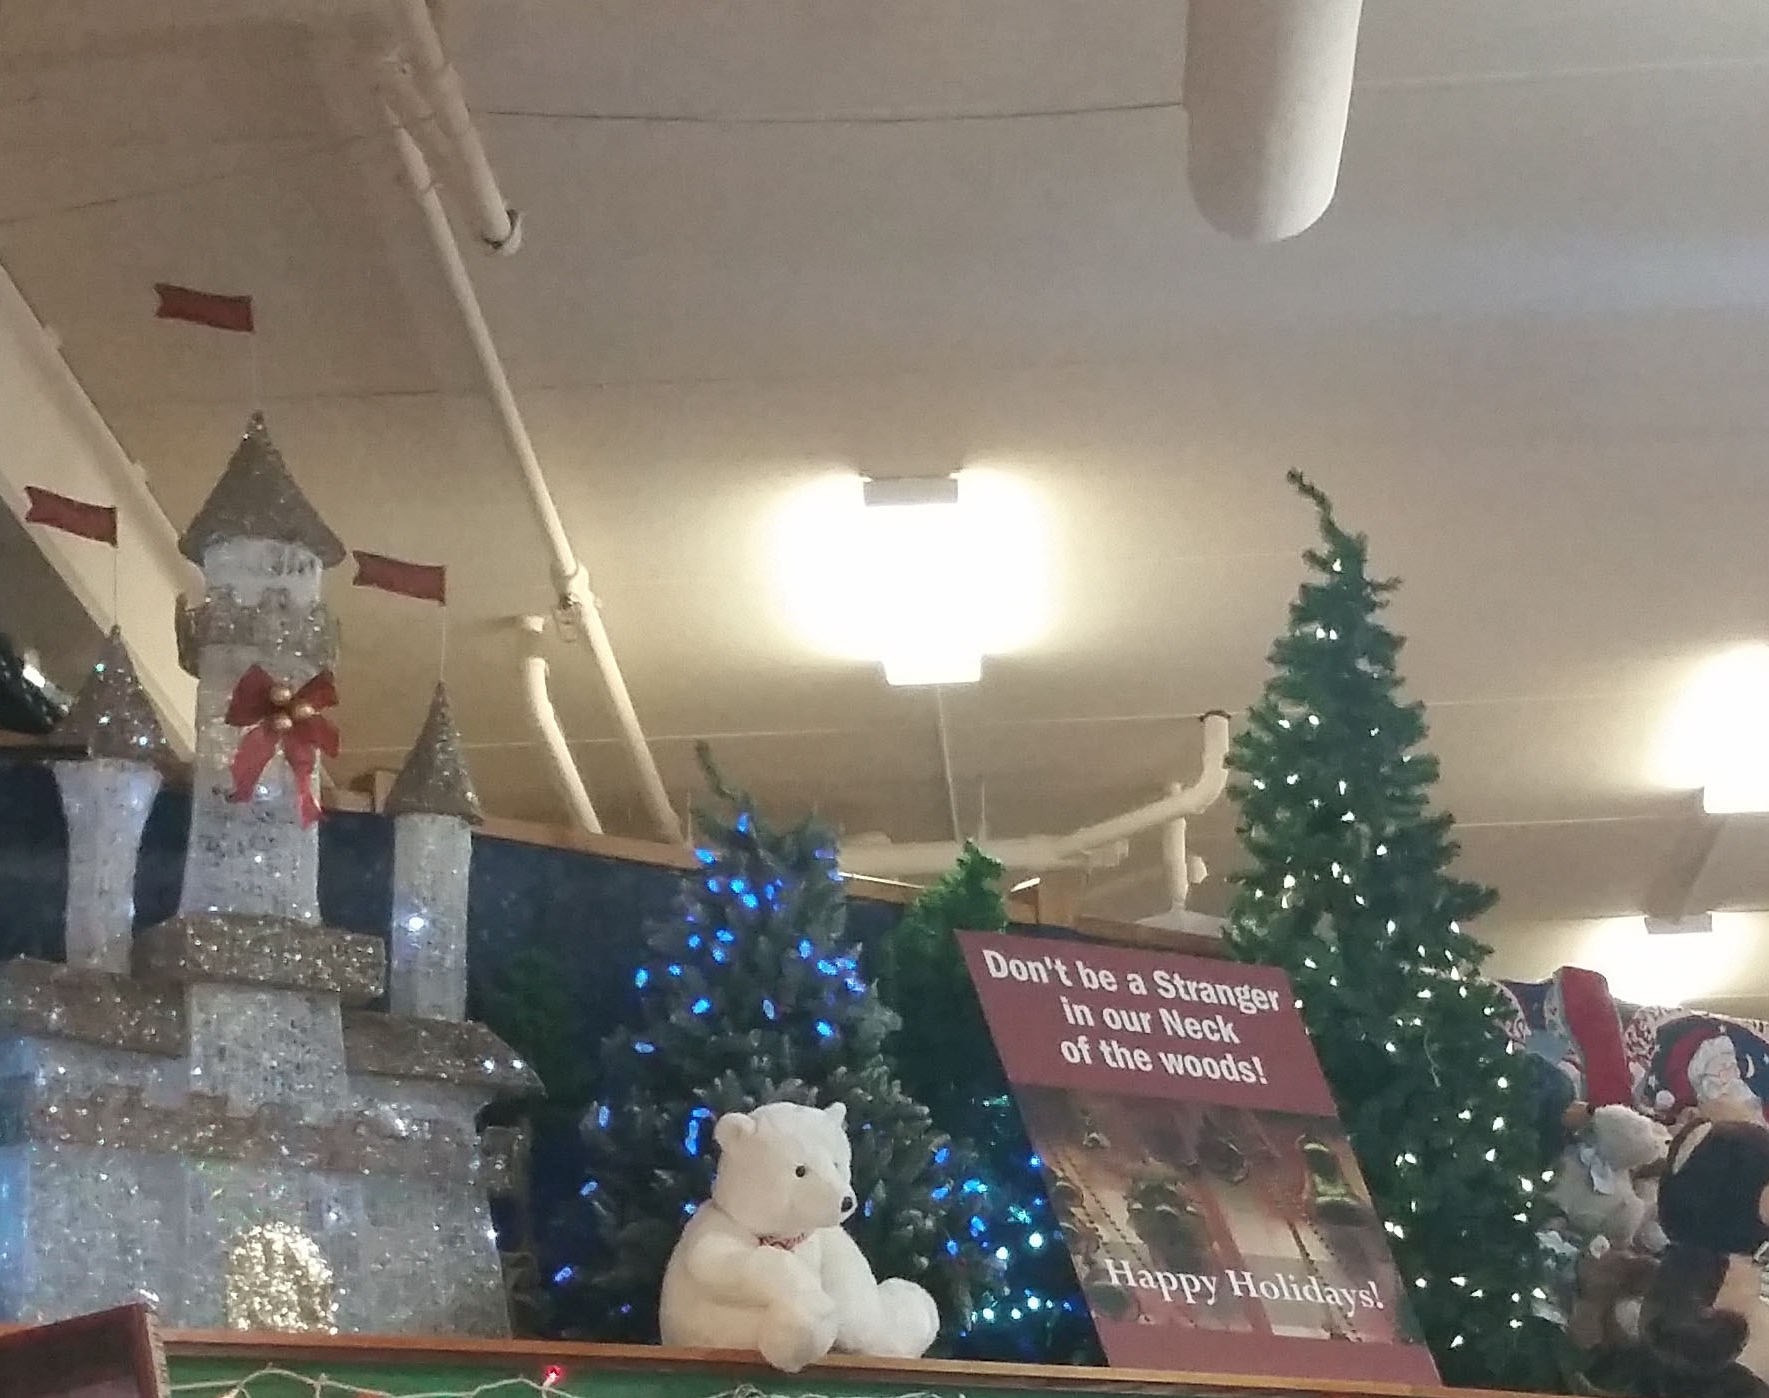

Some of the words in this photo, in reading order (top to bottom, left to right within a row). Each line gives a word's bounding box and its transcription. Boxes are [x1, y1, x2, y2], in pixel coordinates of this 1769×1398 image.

[982, 948, 1070, 988] Don't
[1080, 961, 1117, 993] be
[1128, 972, 1148, 997] a
[1153, 969, 1281, 1015] Stranger
[1061, 996, 1094, 1028] in
[1103, 1005, 1152, 1035] our
[1161, 1011, 1242, 1045] Neck
[1059, 1036, 1093, 1065] of
[1099, 1039, 1153, 1073] the
[1158, 1051, 1270, 1086] woods!
[1104, 1258, 1219, 1305] Happy
[1225, 1269, 1385, 1311] Holidays!
